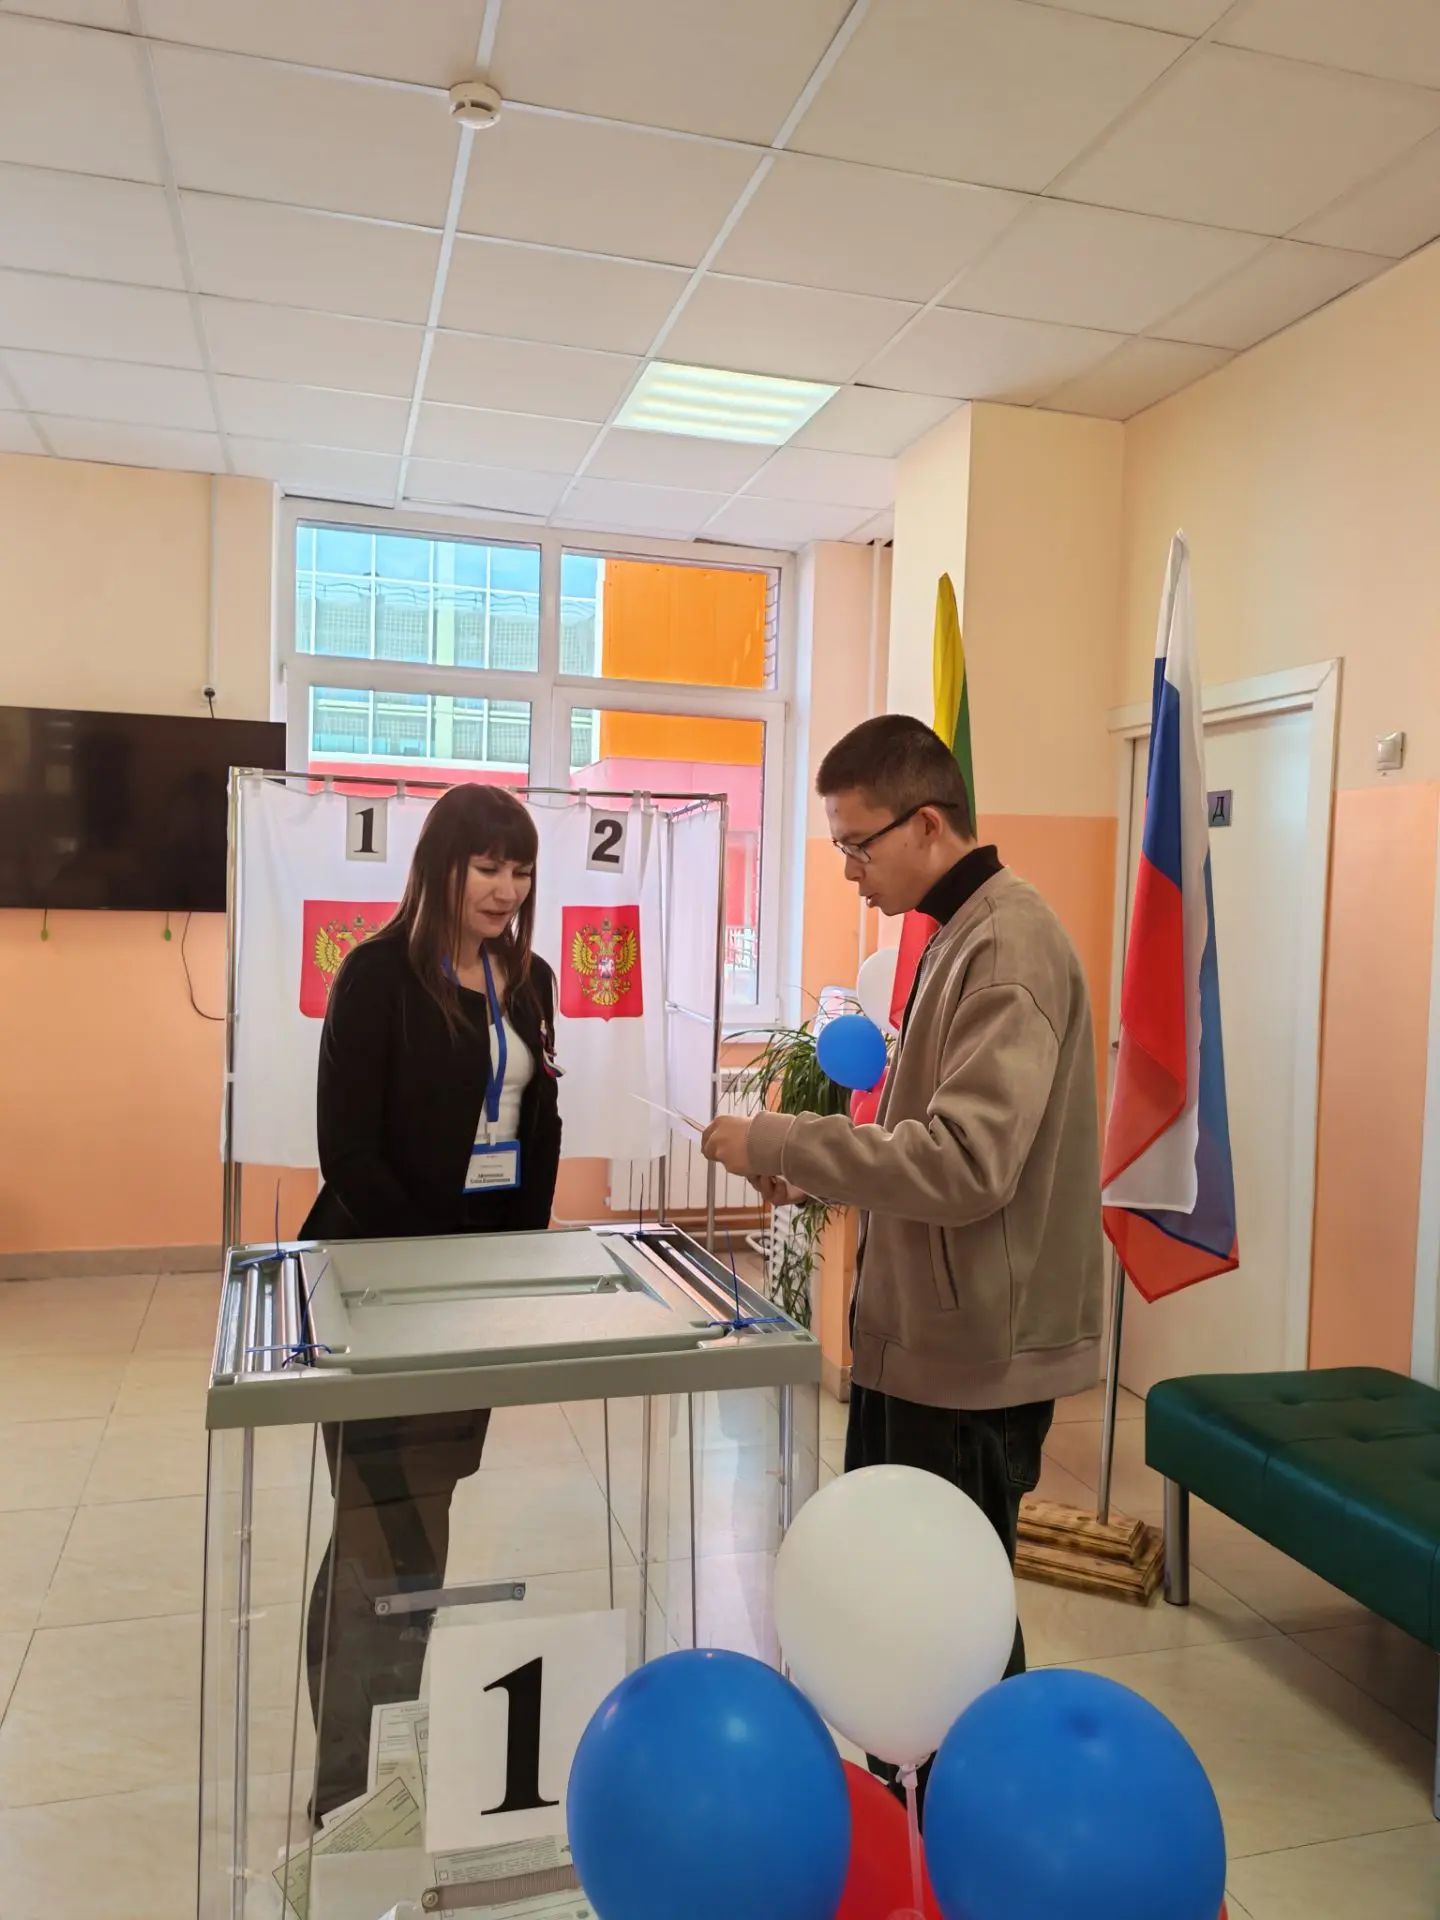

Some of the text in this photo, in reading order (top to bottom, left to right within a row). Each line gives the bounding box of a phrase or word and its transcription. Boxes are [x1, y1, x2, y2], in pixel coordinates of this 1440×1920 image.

[354, 807, 379, 854] 1
[1212, 796, 1225, 823] Д
[591, 819, 624, 864] 2
[480, 1656, 560, 1816] 1
